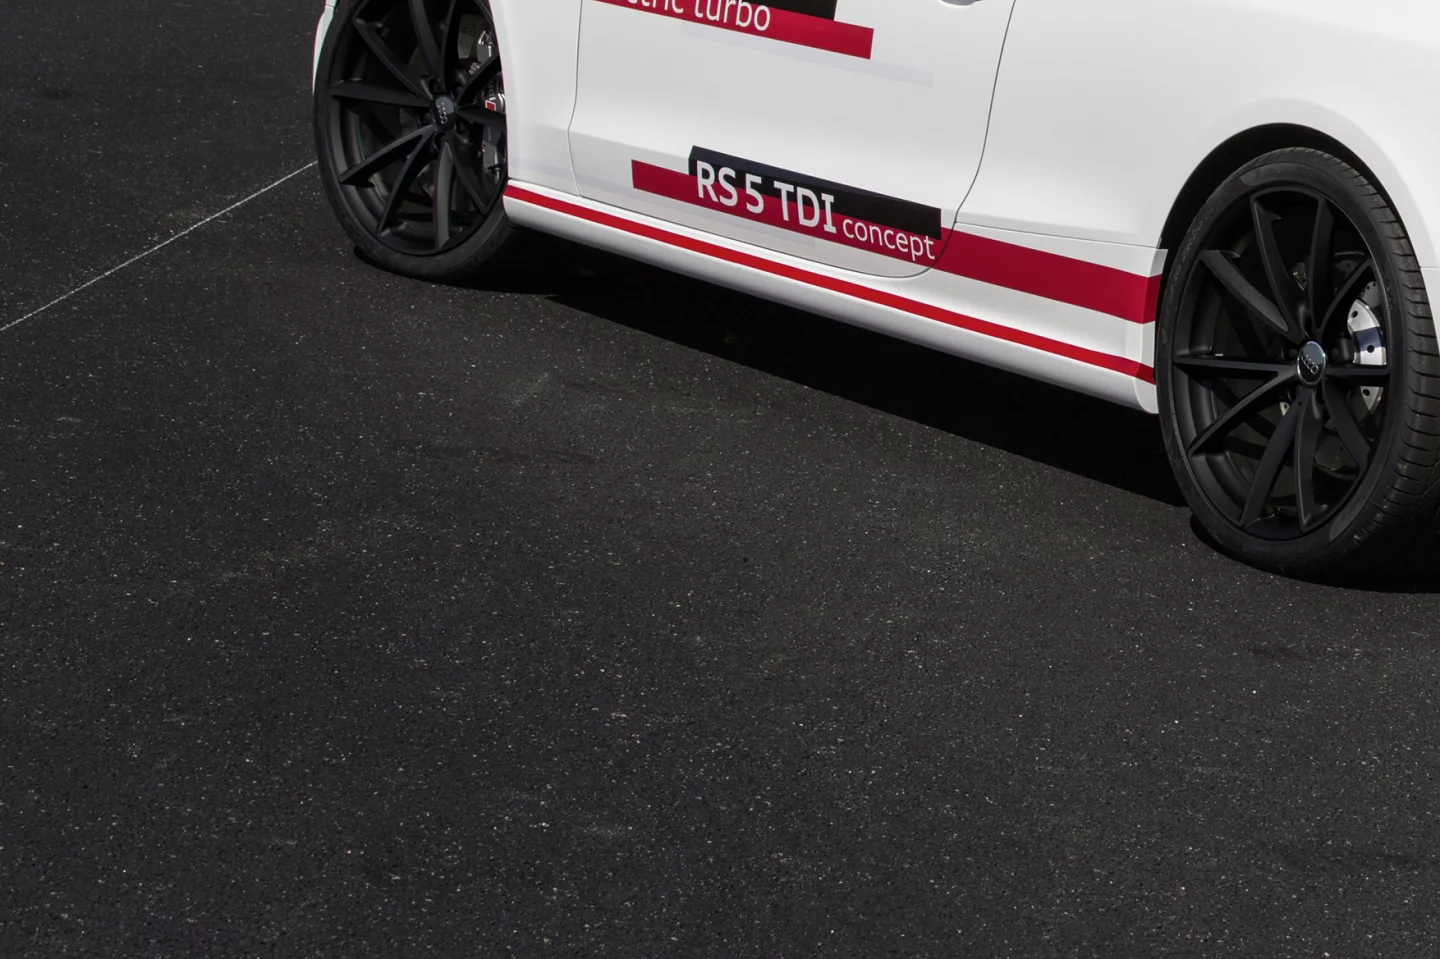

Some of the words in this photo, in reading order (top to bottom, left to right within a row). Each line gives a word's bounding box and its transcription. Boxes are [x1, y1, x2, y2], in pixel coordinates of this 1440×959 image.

[696, 160, 738, 207] RS
[745, 173, 764, 214] 5
[773, 180, 837, 234] TDI
[842, 218, 935, 261] concept
